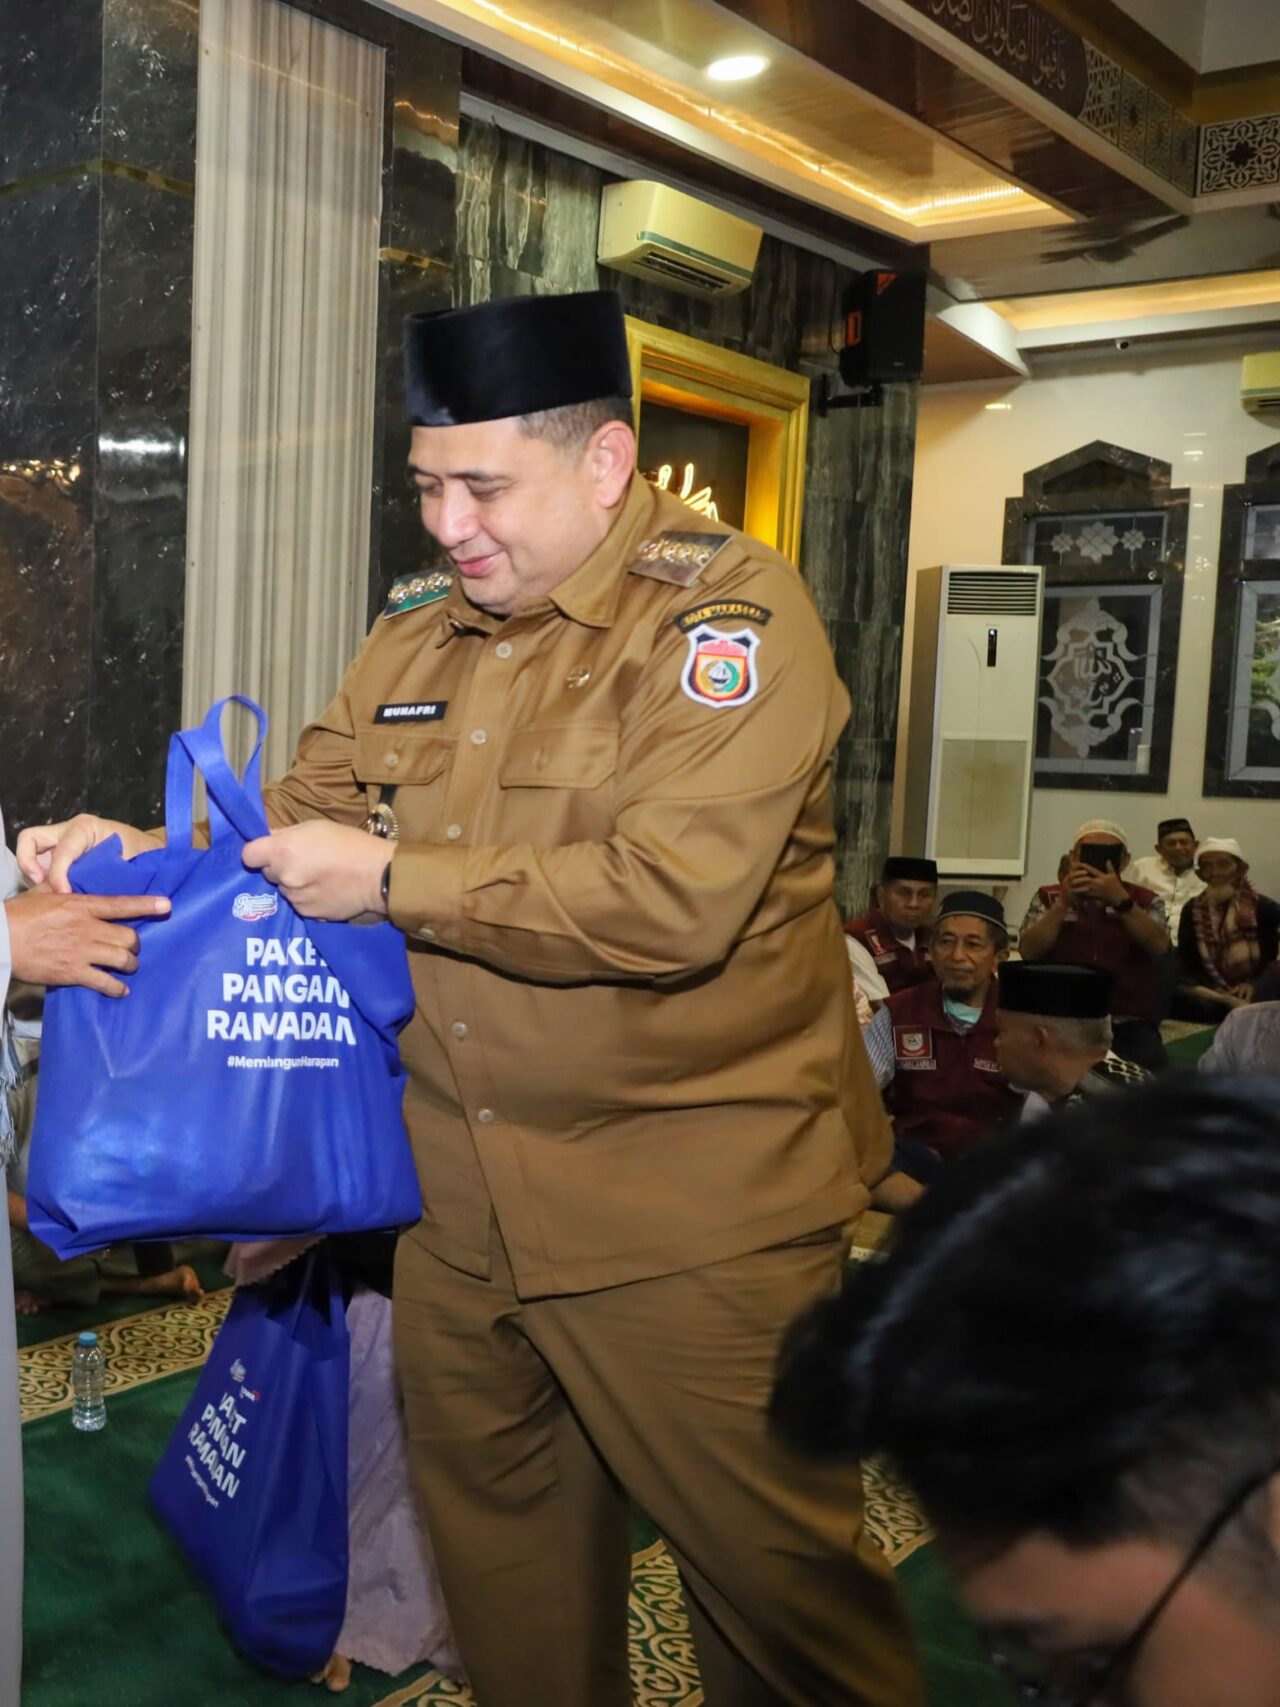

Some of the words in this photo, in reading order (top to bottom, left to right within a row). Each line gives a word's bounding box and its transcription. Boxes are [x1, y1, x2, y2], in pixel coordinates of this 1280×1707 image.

[246, 937, 328, 967] PAKE
[222, 972, 350, 1009] PANGAN
[207, 1009, 357, 1046] RAMADAN
[187, 1422, 240, 1499] RAMAAN
